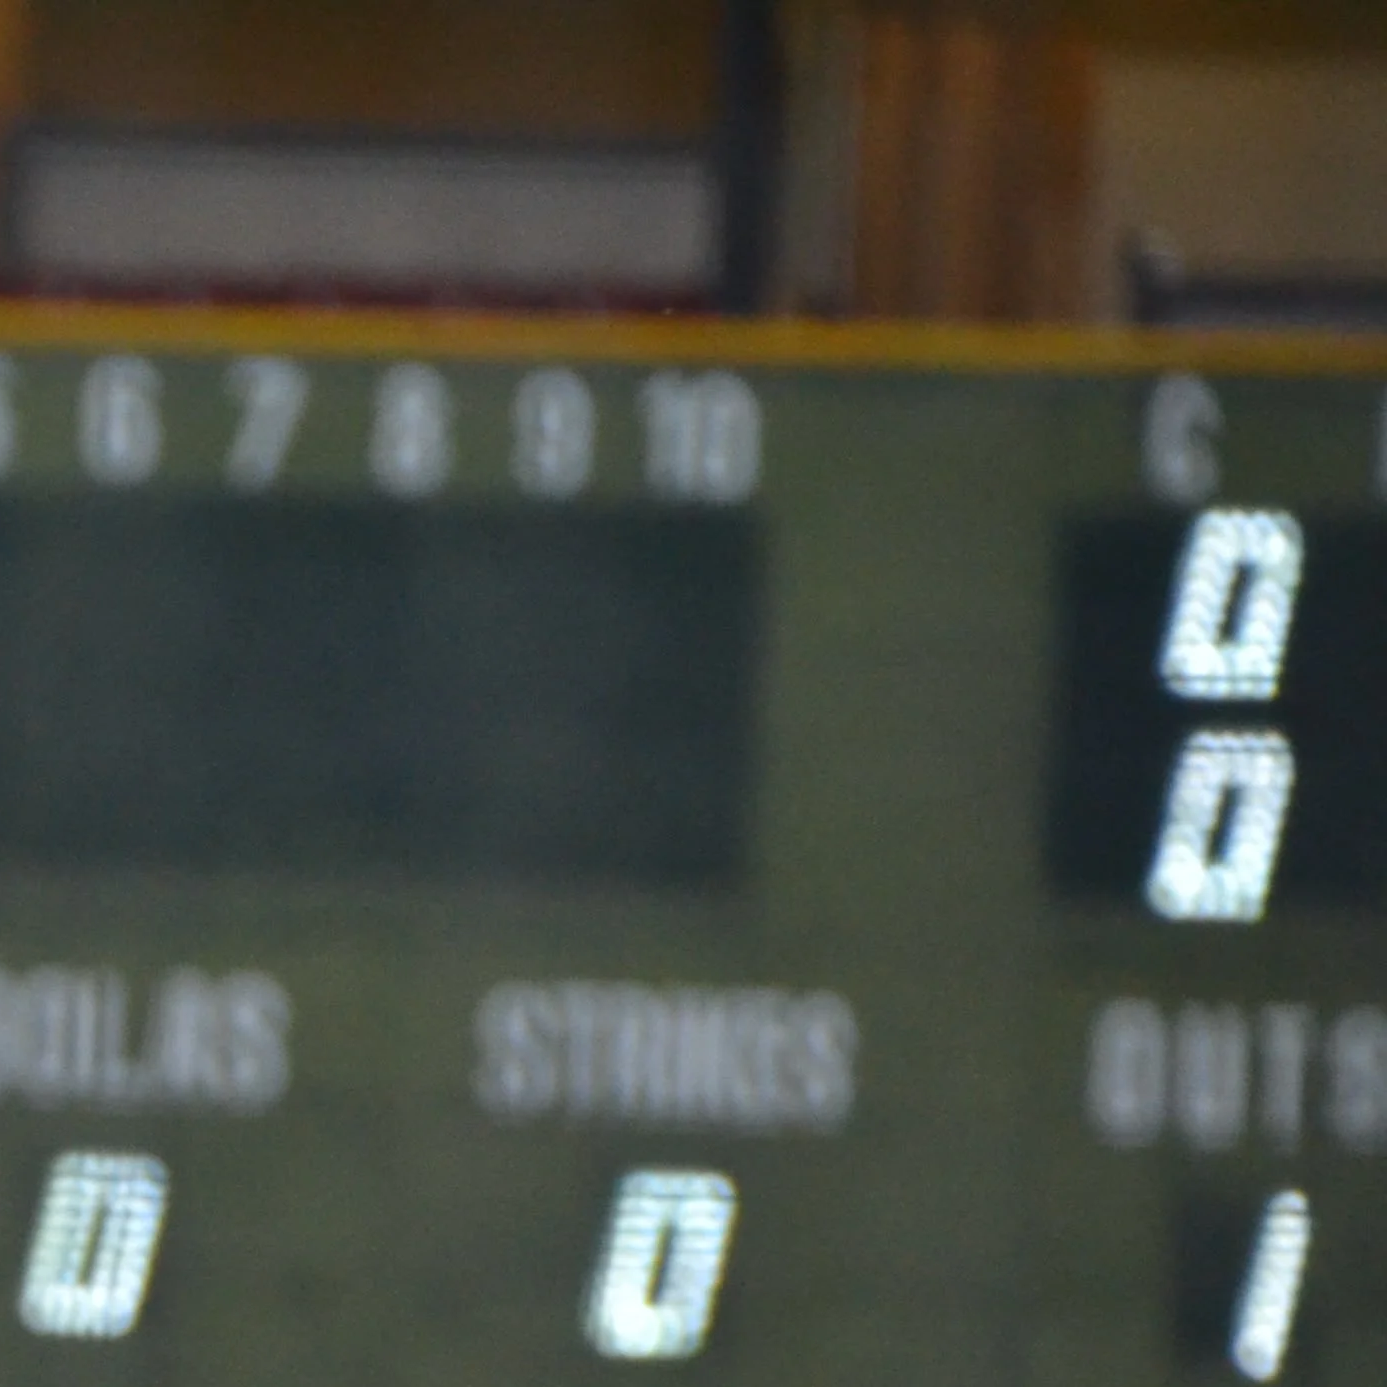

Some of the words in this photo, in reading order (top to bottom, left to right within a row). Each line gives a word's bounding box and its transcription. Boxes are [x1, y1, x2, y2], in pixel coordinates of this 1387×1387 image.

[77, 352, 165, 486] 6
[225, 354, 309, 490] 7
[639, 366, 762, 505] 10
[1159, 508, 1304, 700] 0
[1147, 730, 1296, 922] 0
[472, 974, 857, 1136] STRIKES
[1085, 996, 1387, 1156] OUTS
[17, 1150, 170, 1338] 0
[582, 1168, 739, 1360] 0
[1231, 1188, 1313, 1384] 1
